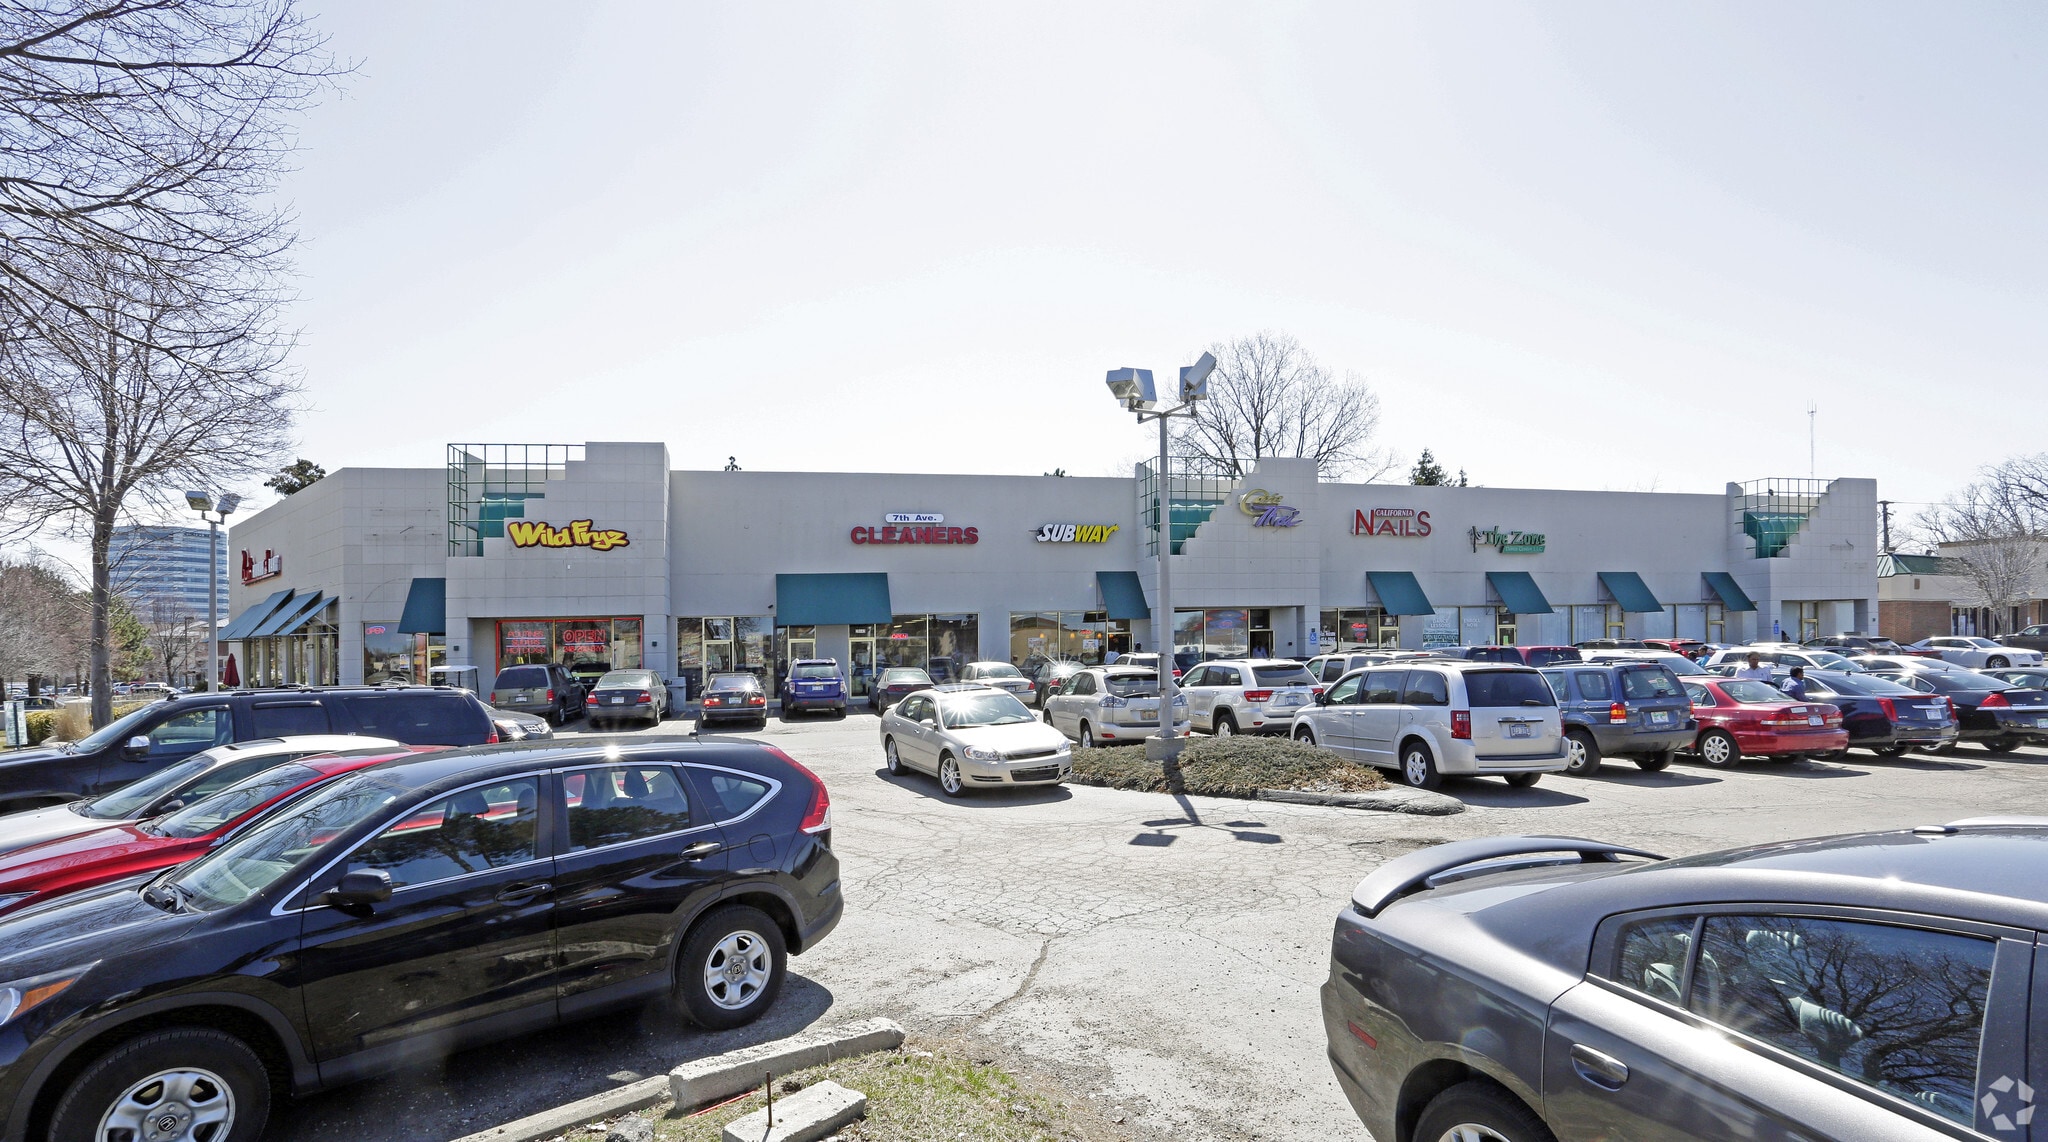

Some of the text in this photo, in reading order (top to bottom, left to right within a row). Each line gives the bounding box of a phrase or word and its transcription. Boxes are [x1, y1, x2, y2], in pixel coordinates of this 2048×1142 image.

[892, 514, 937, 522] 7th Ave.
[1376, 509, 1413, 517] CALIFORNIA
[1354, 509, 1432, 537] NAILS
[508, 519, 630, 551] Wild Fryz
[850, 526, 979, 545] CLEANERS
[1036, 523, 1120, 543] SUBWAY
[1482, 526, 1546, 547] The Zone
[563, 629, 606, 643] OPEN
